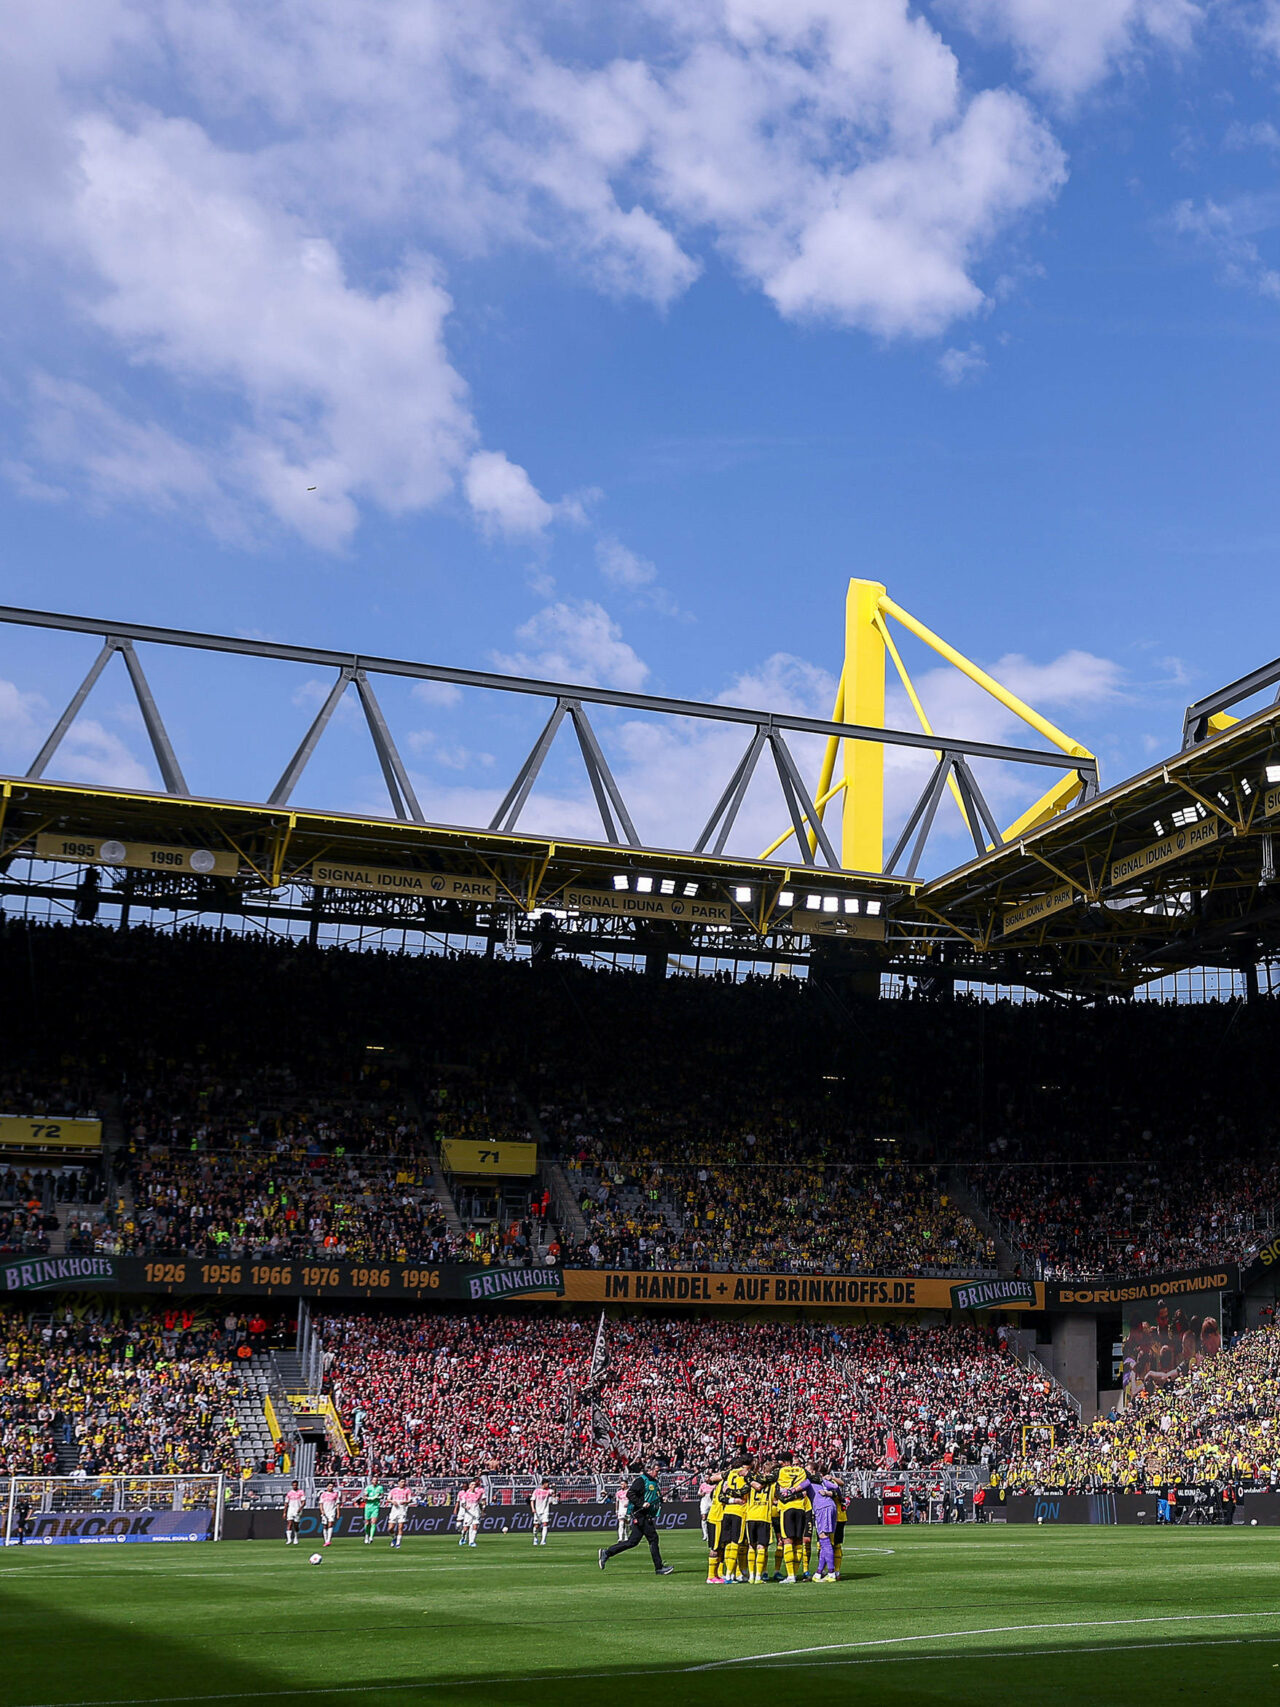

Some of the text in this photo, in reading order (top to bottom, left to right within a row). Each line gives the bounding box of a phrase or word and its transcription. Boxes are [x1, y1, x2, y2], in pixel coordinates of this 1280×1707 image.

[62, 842, 183, 866] 1995 1996
[1113, 822, 1215, 879] SIGNAL IDUNA PARK
[318, 868, 491, 896] SIGNAL IDUNA PARK
[568, 893, 727, 919] SIGNAL IDUNA PARK
[1005, 890, 1070, 927] SIGNAL IDUNA PARK
[30, 1124, 61, 1138] 72
[478, 1150, 499, 1163] 71
[144, 1263, 440, 1289] 1926 1956 1966 1976 1986 1996
[1059, 1273, 1228, 1303] BORUSSIA DORTMUND
[605, 1275, 629, 1298] IM
[636, 1276, 711, 1299] HANDEL
[734, 1278, 770, 1300] AUF
[775, 1279, 915, 1304] BRINKHOFFS.DE
[789, 1474, 799, 1488] 7
